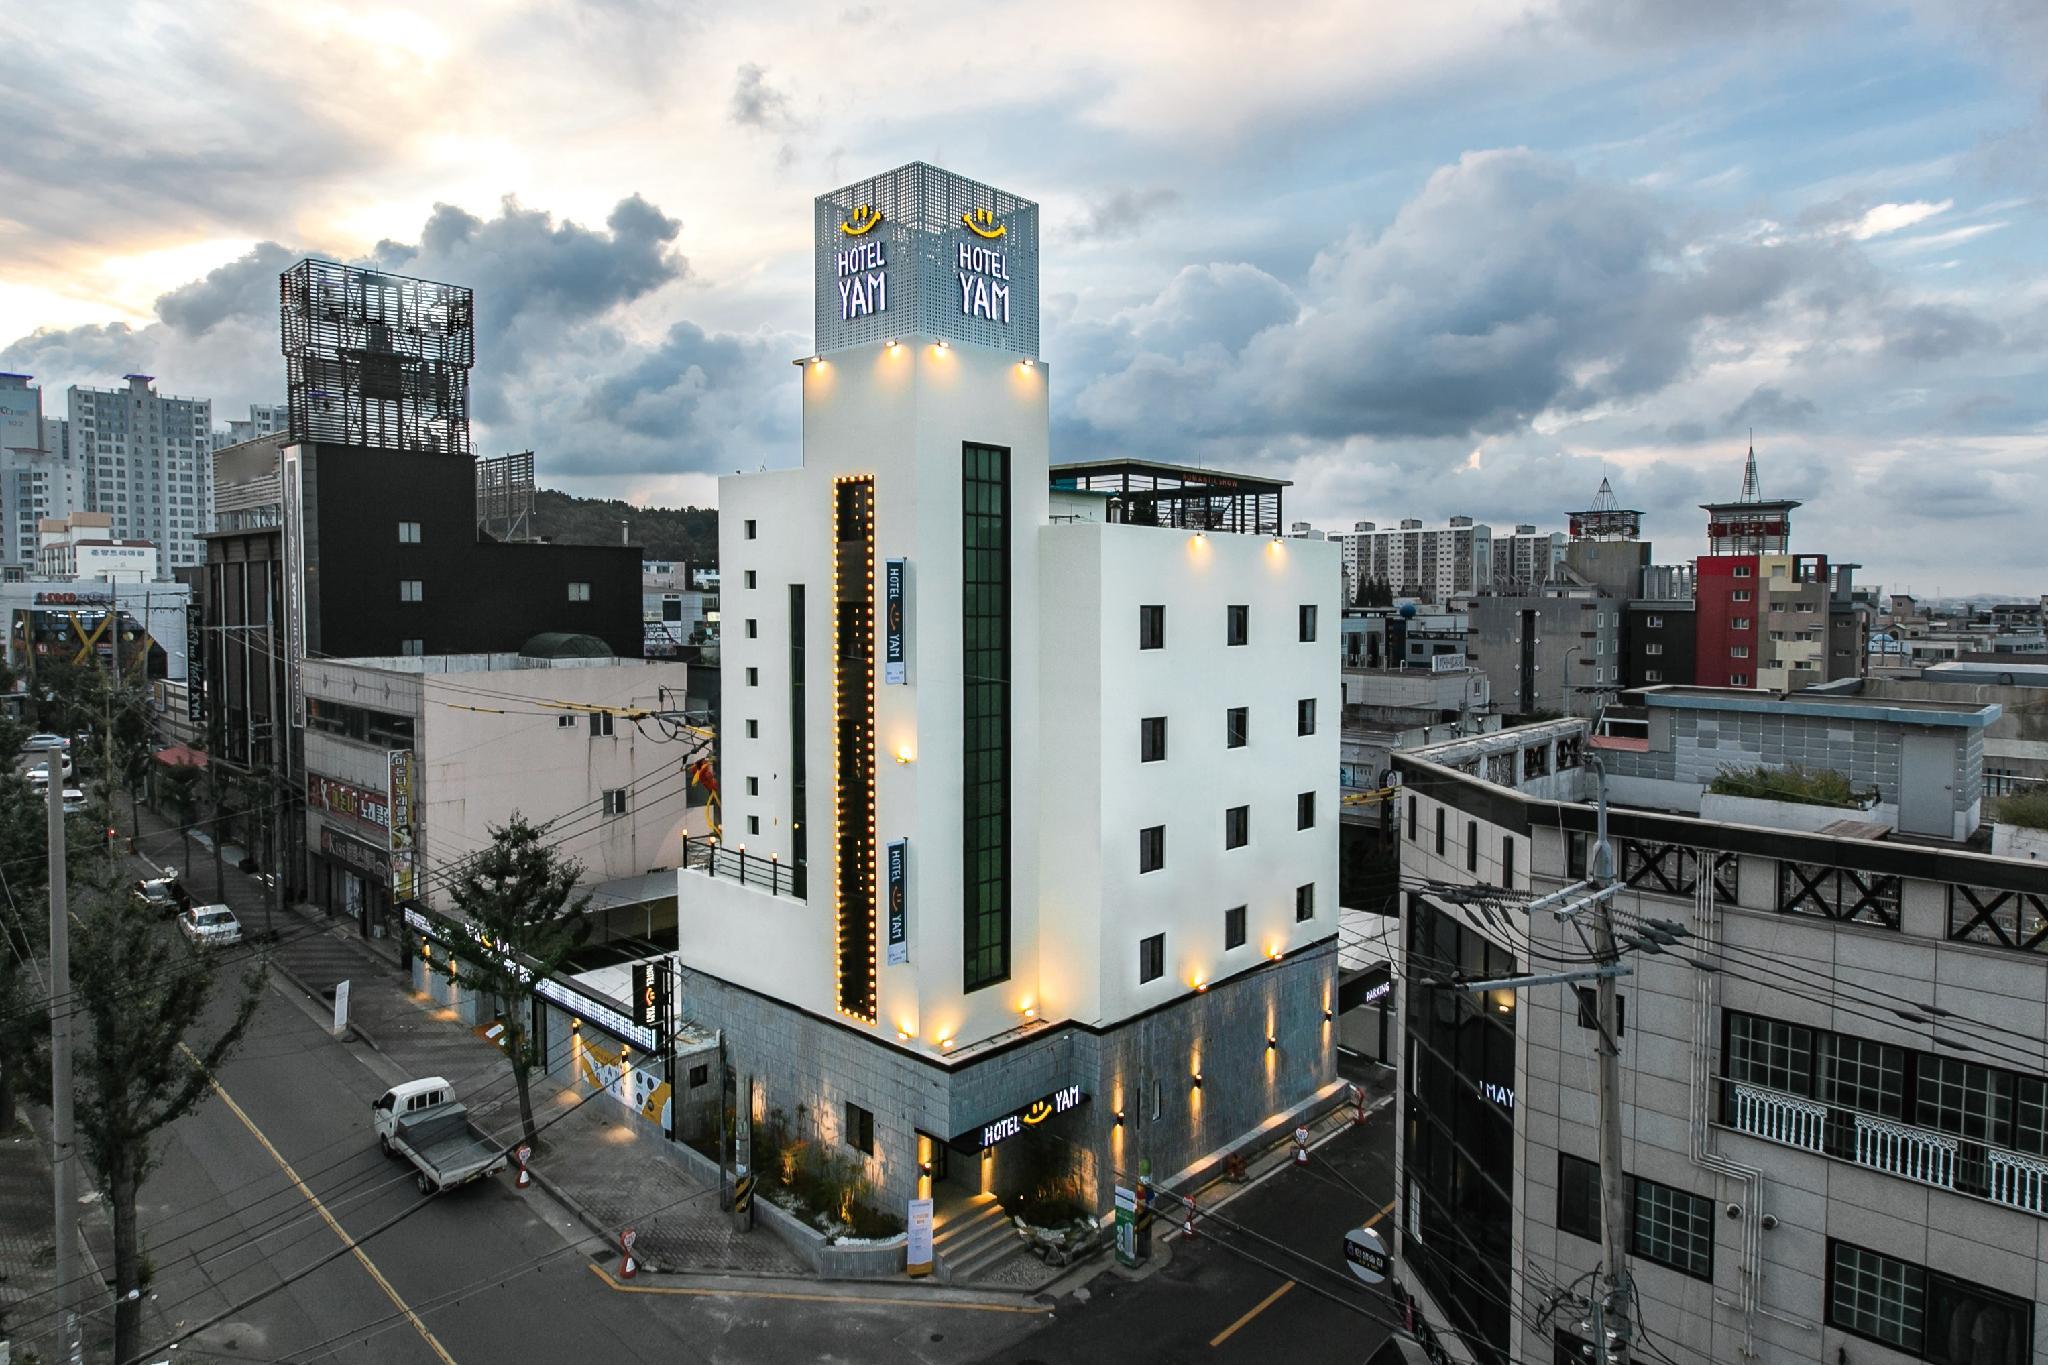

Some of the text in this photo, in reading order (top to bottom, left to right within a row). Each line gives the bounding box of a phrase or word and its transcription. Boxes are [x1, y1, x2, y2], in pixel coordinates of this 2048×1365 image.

[838, 241, 886, 277] HOTEL
[959, 242, 1010, 281] HOTEL
[838, 272, 887, 321] YAM
[959, 272, 1010, 324] YAM
[889, 568, 900, 657] HOTEL YAM
[891, 850, 901, 883] HOTEL
[891, 914, 902, 939] YAM
[1366, 981, 1390, 1002] PARKING
[984, 1084, 1079, 1147] HOTEL YAM
